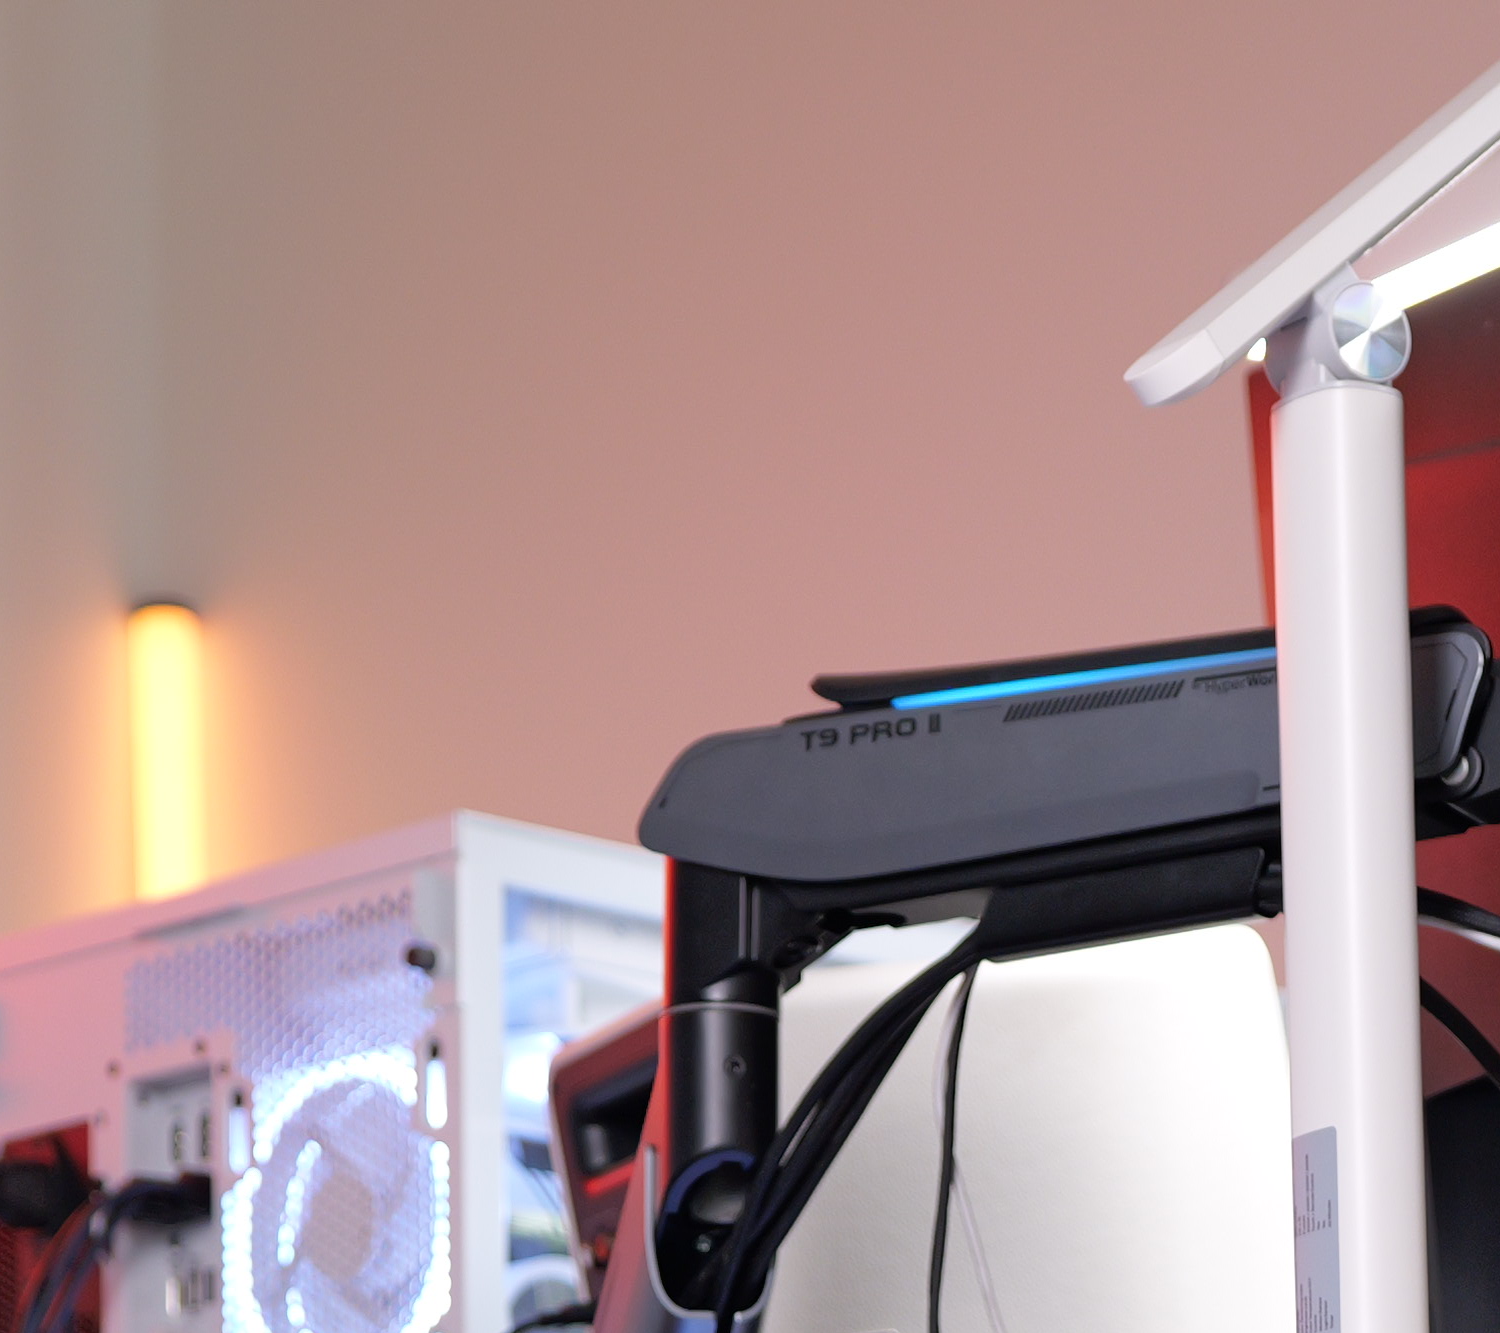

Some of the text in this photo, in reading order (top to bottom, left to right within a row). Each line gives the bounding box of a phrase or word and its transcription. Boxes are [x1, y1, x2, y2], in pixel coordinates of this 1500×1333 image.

[1204, 672, 1277, 694] HyperWor
[800, 728, 839, 751] T9
[849, 717, 917, 745] PRO
